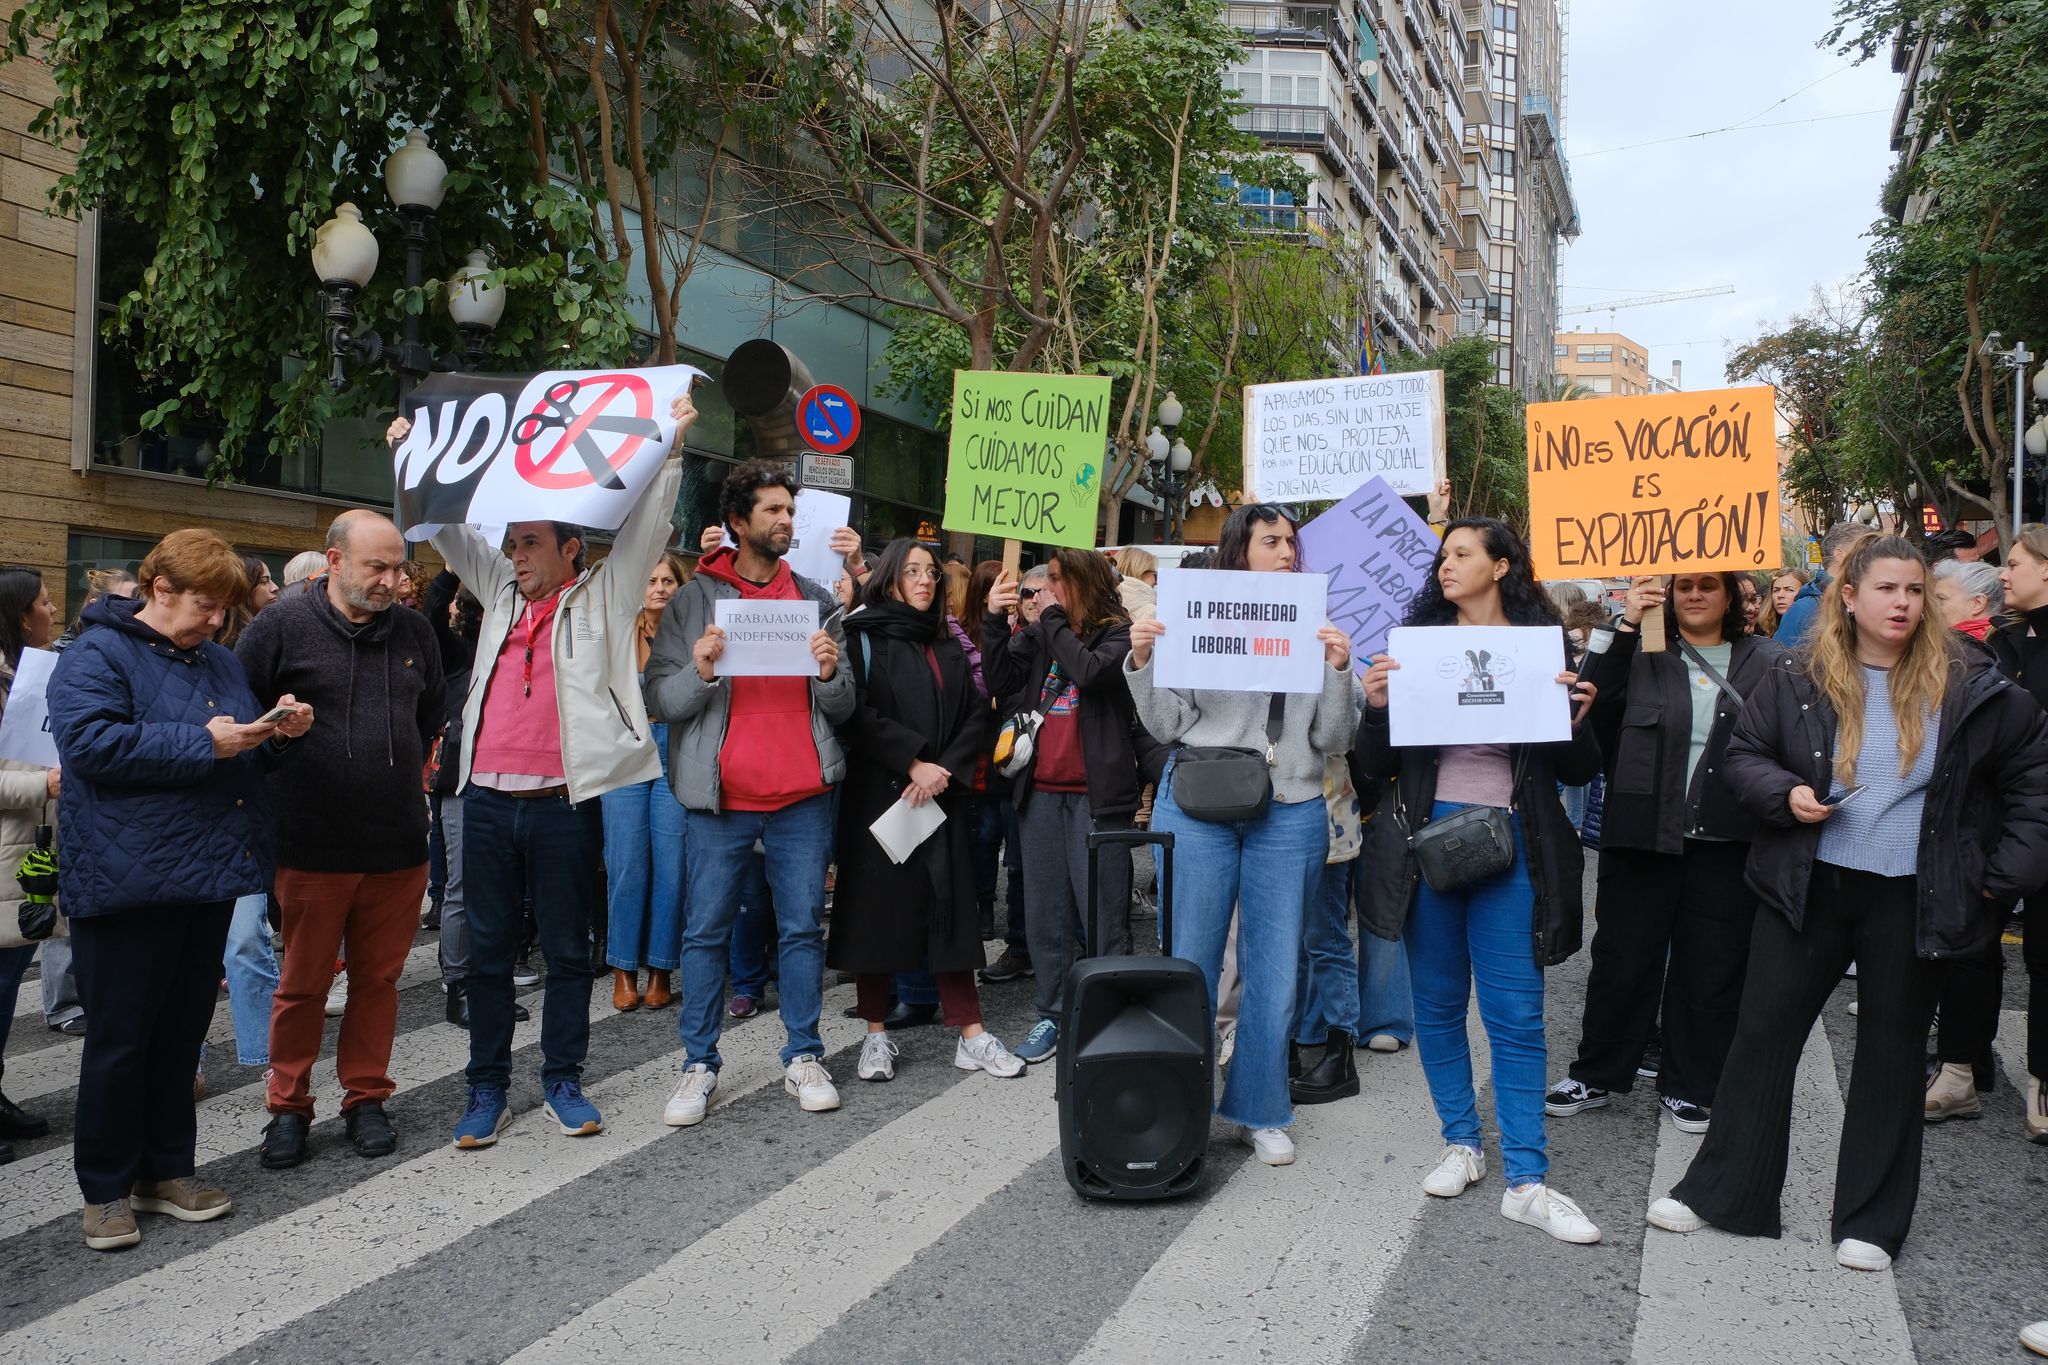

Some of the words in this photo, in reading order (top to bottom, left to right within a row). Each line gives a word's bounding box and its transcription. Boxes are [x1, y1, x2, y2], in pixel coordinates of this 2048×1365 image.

[1263, 385, 1335, 412] APAGAMOS
[1344, 380, 1394, 401] FUEGOS
[1397, 376, 1431, 394] TODOS
[985, 397, 1012, 423] NOS
[1263, 416, 1287, 433] LOS
[1326, 407, 1349, 425] SIN
[1355, 406, 1373, 424] UN
[1377, 401, 1422, 419] TRAJE
[394, 392, 507, 491] NO
[1263, 435, 1293, 455] QUE
[1297, 433, 1328, 451] NOS
[1341, 424, 1411, 448] PROTEJA
[815, 456, 841, 467] RESERVADO
[1262, 457, 1277, 469] POR
[1299, 447, 1371, 476] EDUCACIÓN
[1375, 446, 1425, 471] SOCIAL
[1584, 441, 1614, 465] ES
[1277, 478, 1321, 497] DIGNA
[1632, 473, 1662, 498] ES
[971, 484, 1066, 534] MEJOR
[1350, 492, 1389, 529] LA
[1359, 551, 1413, 611] LABO
[726, 613, 810, 624] TRABAJAMOS
[1187, 600, 1202, 619] LA
[1207, 601, 1298, 622] PRECARIEDAD
[729, 631, 808, 642] INDEFENSOS
[1191, 635, 1248, 655] LABORAL
[1253, 637, 1290, 656] MATA
